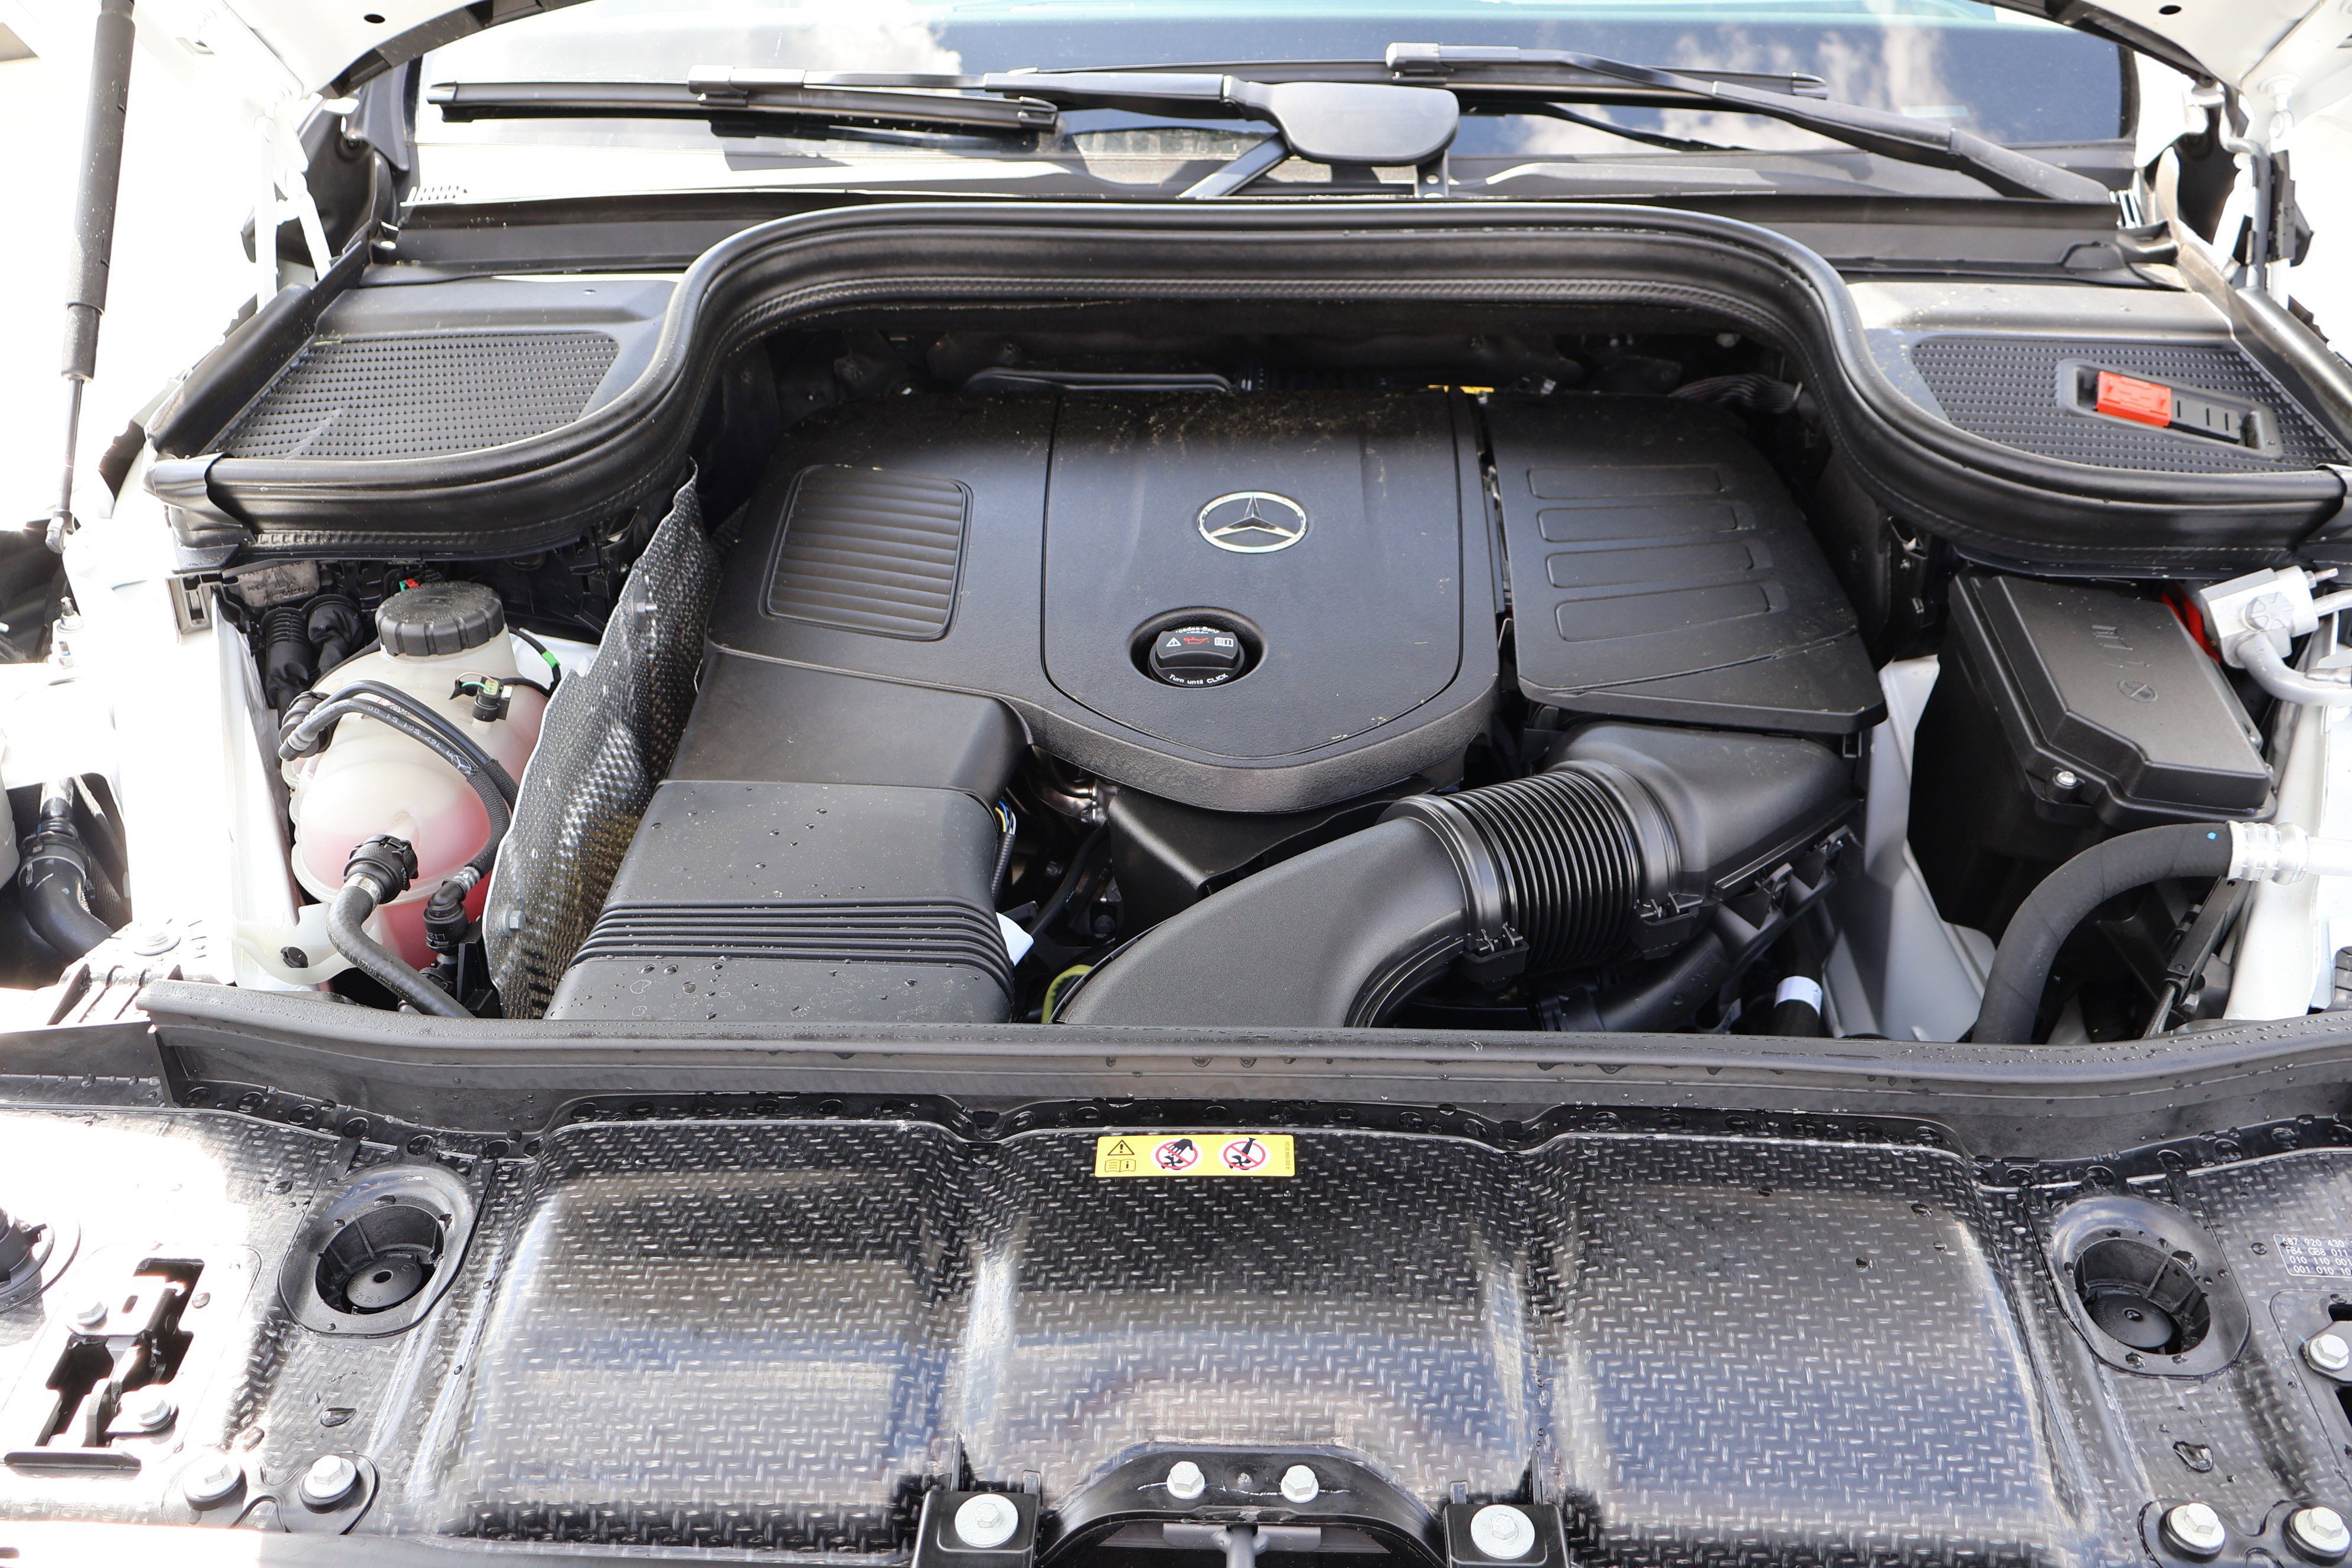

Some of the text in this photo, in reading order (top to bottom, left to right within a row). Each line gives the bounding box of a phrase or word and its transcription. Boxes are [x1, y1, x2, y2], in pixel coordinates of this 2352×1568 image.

[1169, 674, 1185, 683] Turn
[1206, 673, 1229, 684] CLICK
[386, 714, 399, 723] 51
[424, 736, 442, 748] 167
[2304, 1238, 2322, 1246] 920
[2327, 1239, 2345, 1247] 430
[2308, 1247, 2326, 1256] GB8
[2289, 1256, 2352, 1266] 010 110 001
[2293, 1265, 2311, 1273] 001
[2316, 1266, 2334, 1275] 010
